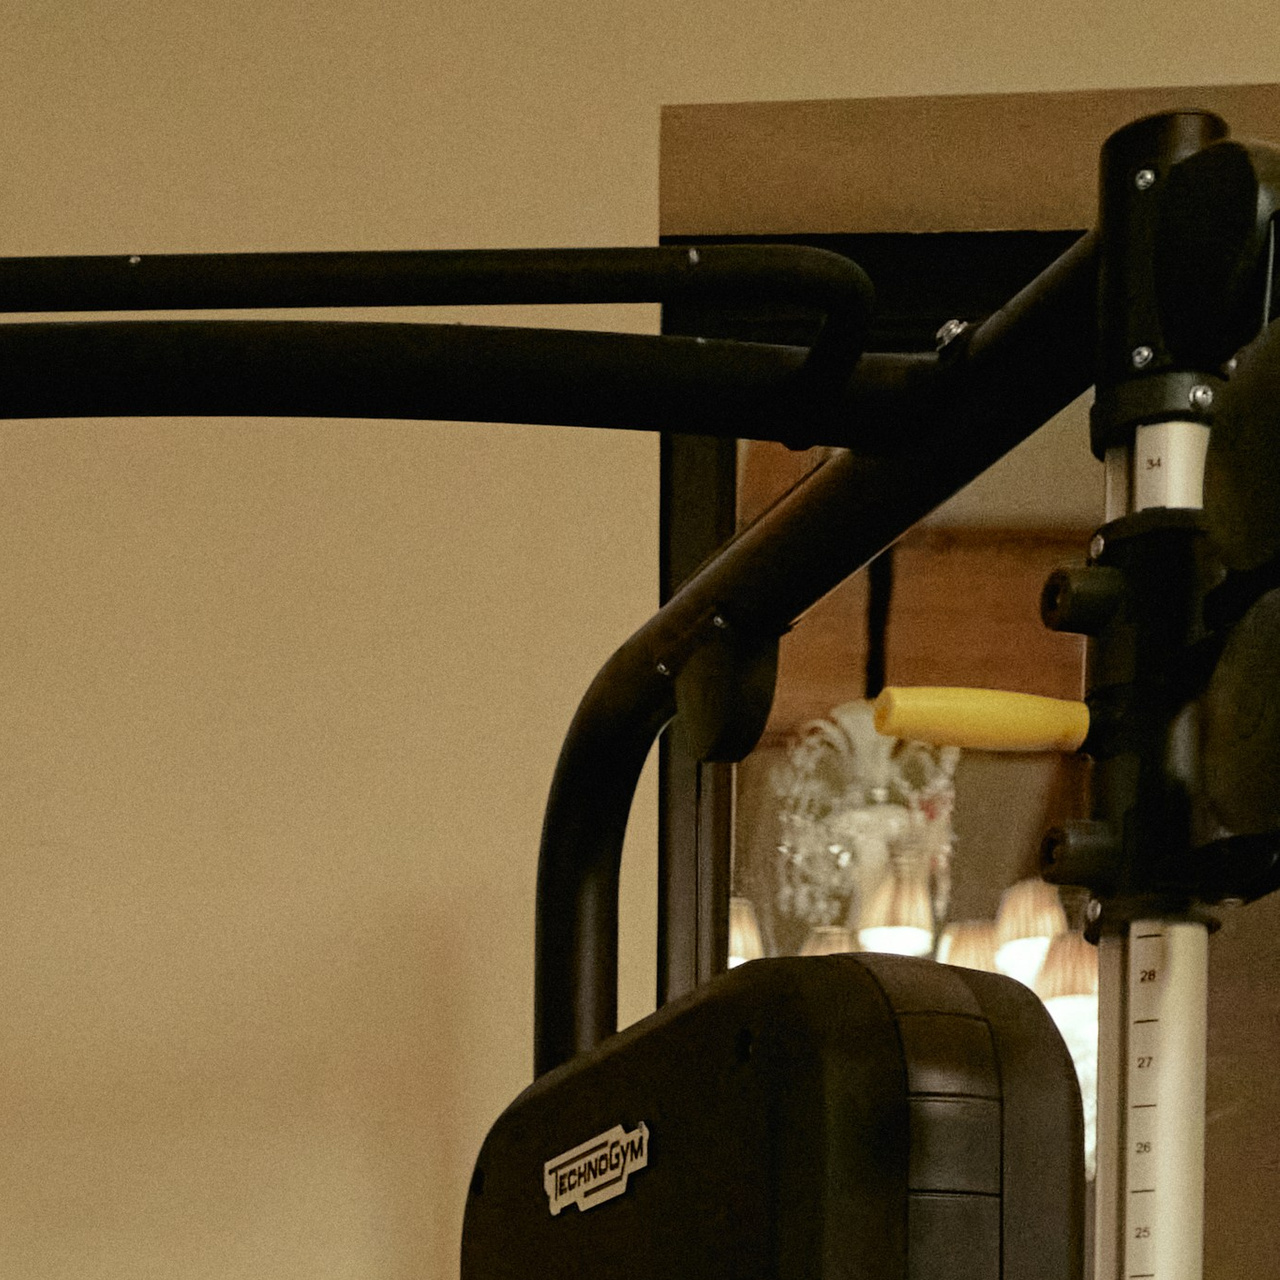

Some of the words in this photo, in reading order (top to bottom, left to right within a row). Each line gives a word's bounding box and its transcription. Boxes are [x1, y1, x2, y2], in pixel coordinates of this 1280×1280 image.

[1146, 457, 1162, 470] 34
[1140, 969, 1156, 983] 28
[1137, 1056, 1153, 1069] 27
[1136, 1142, 1151, 1154] 26
[1135, 1226, 1151, 1239] 25
